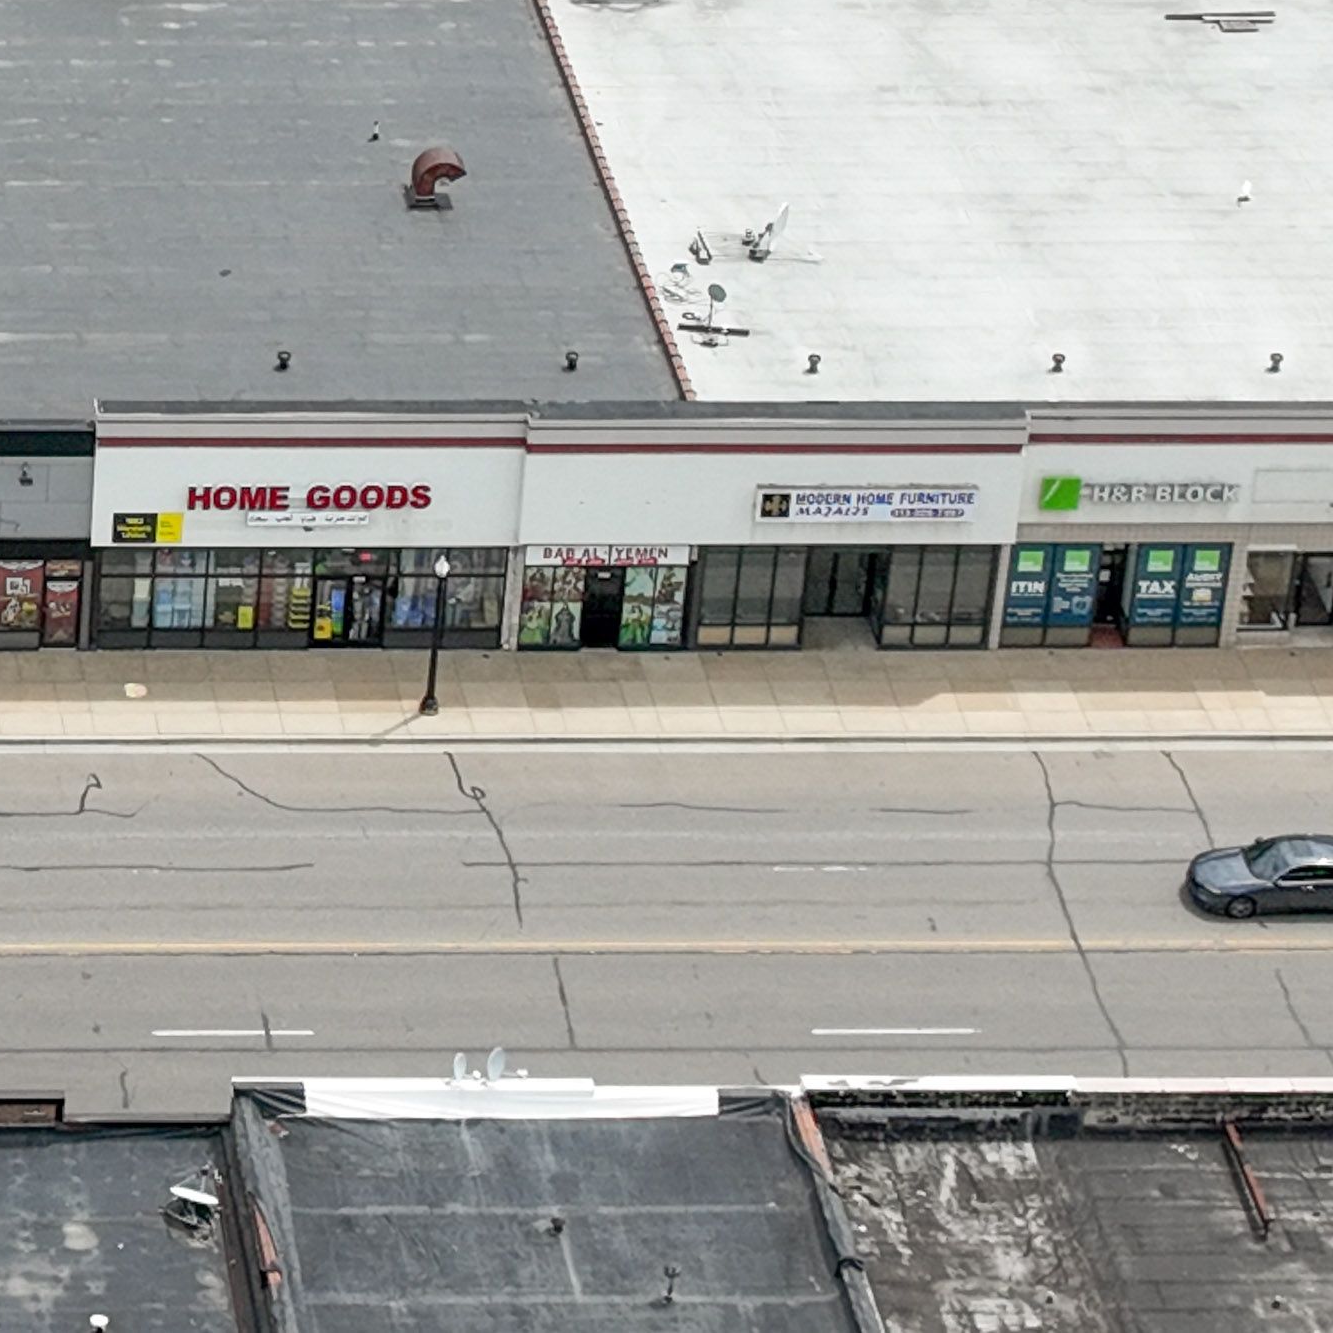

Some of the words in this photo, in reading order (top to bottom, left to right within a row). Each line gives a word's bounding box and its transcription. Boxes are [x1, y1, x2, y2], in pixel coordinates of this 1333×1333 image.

[186, 485, 290, 511] HOME
[305, 483, 432, 510] GOODS
[796, 492, 851, 504] MODERN
[856, 492, 894, 505] HOME
[900, 492, 975, 505] FURNITURE
[1091, 484, 1147, 503] H&R
[1155, 484, 1239, 503] BLOCK
[1137, 579, 1175, 595] TAX
